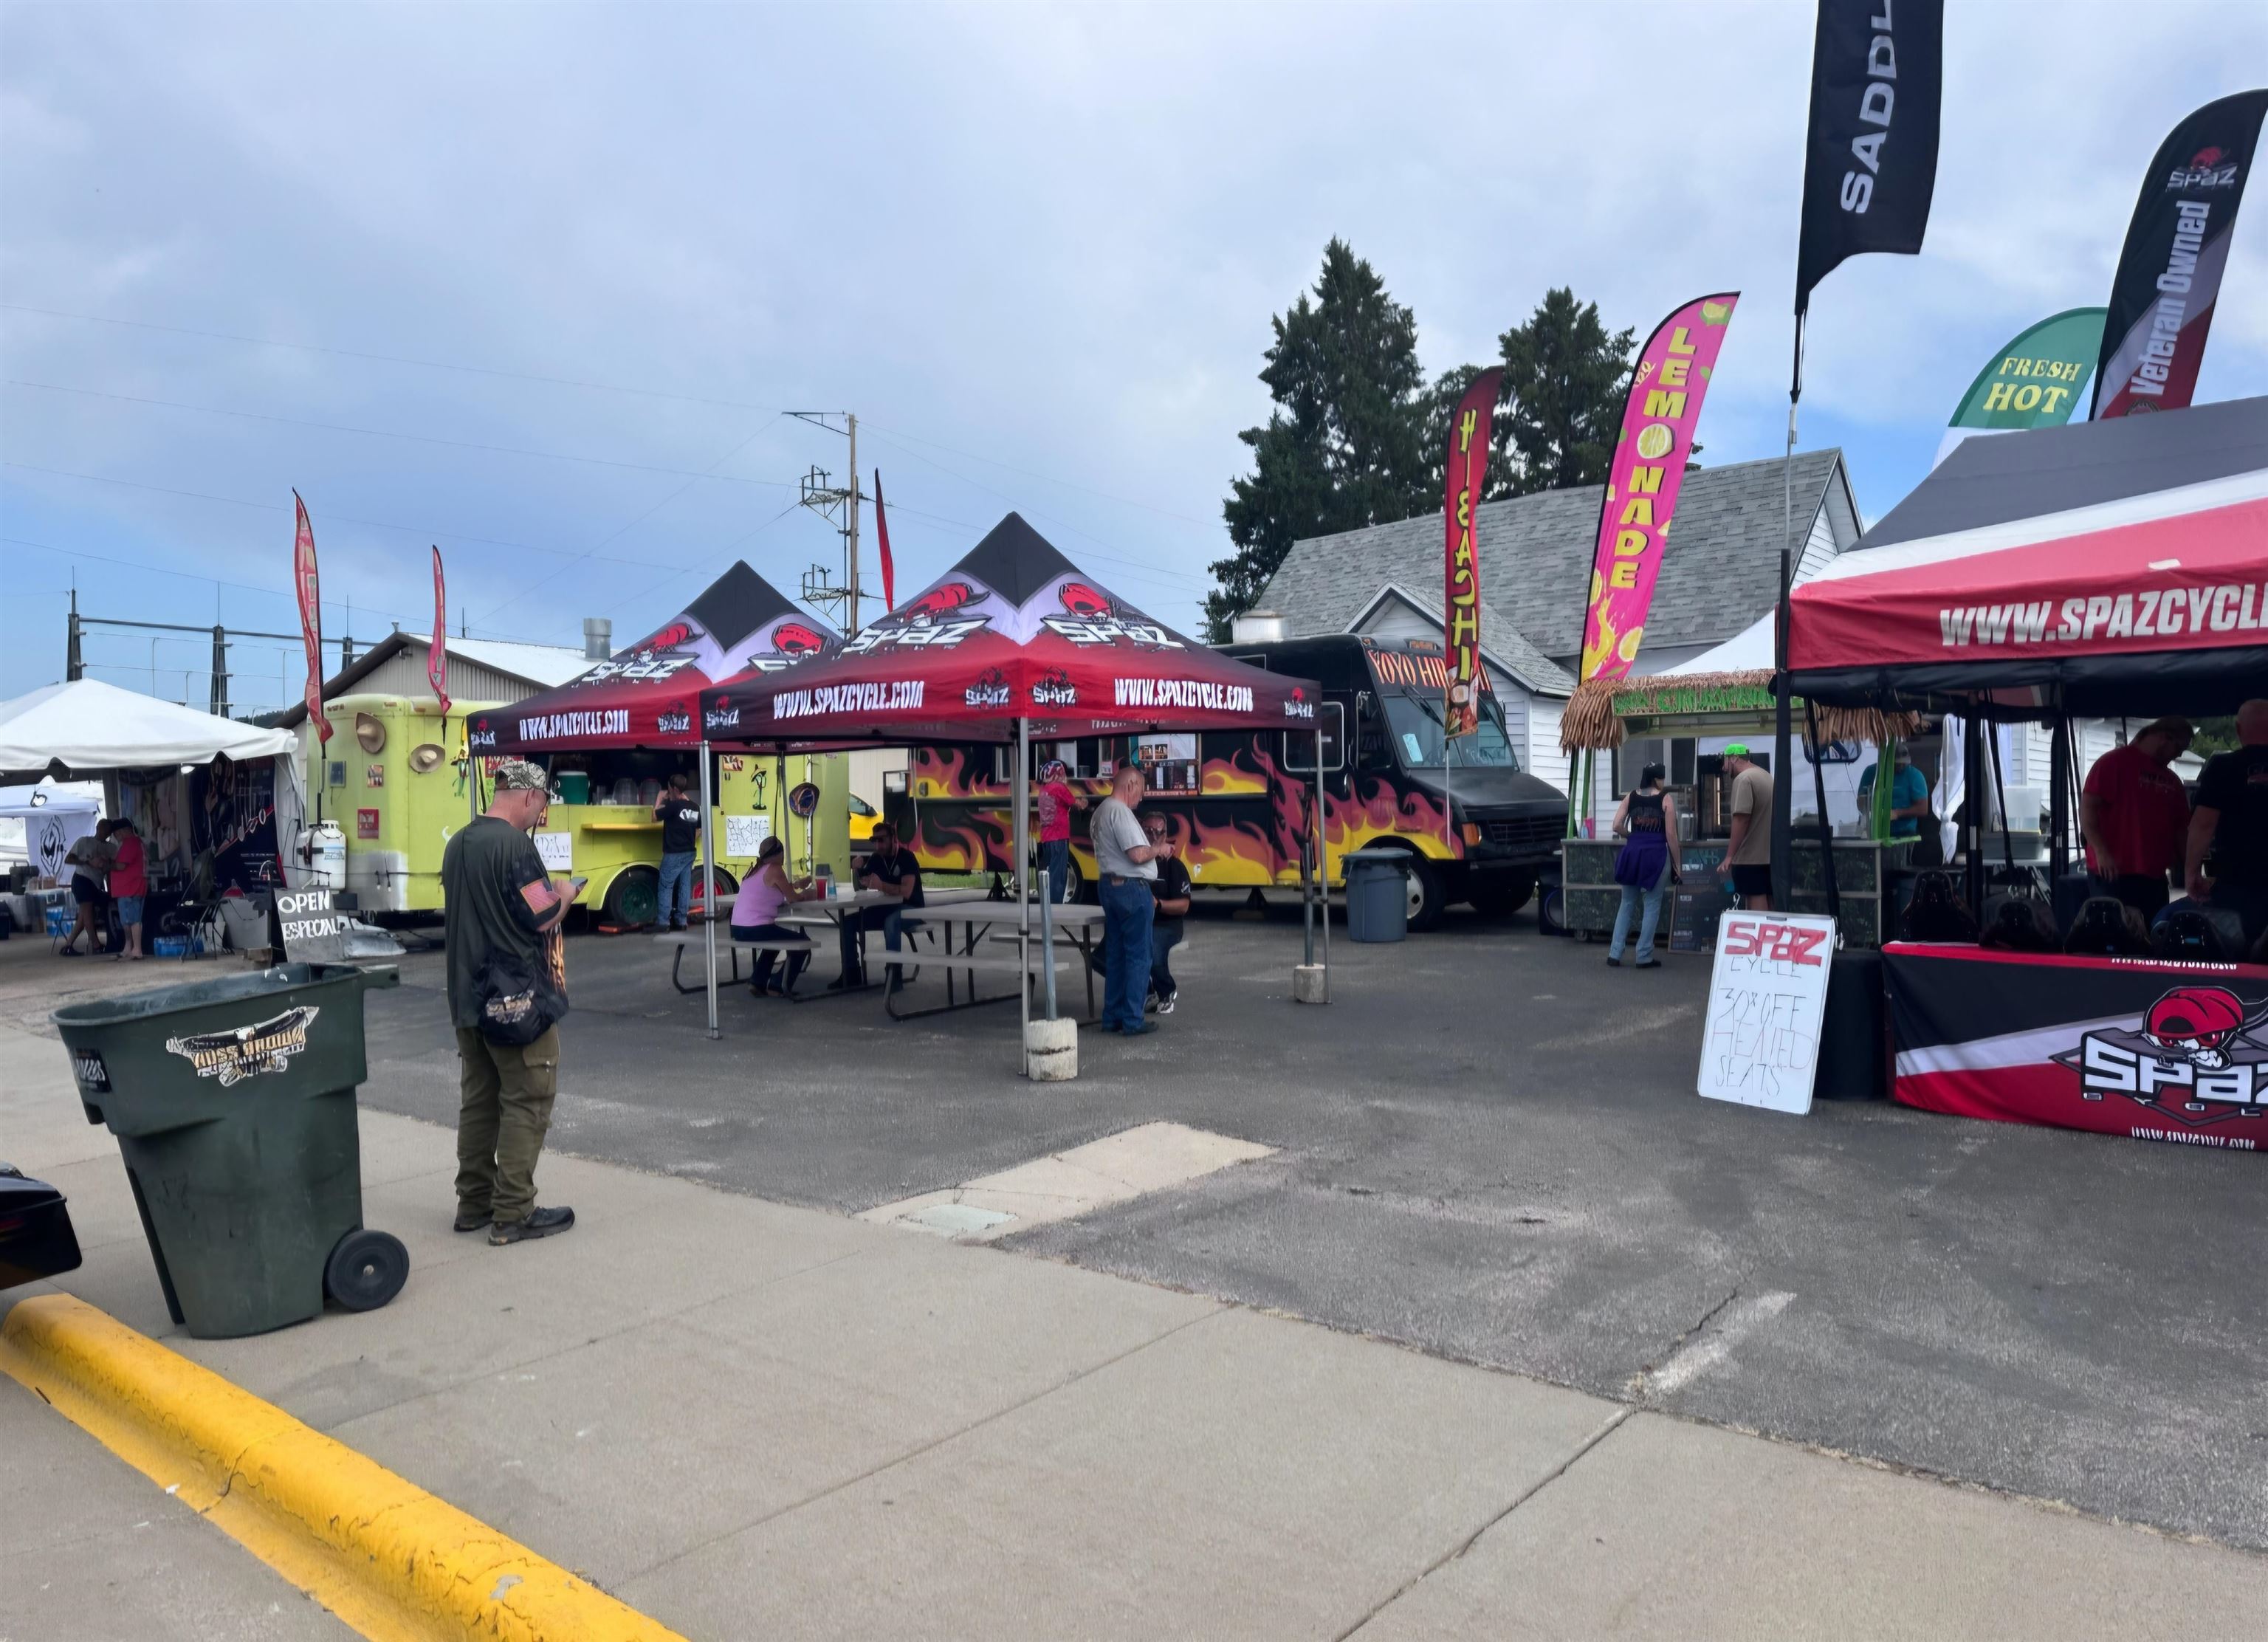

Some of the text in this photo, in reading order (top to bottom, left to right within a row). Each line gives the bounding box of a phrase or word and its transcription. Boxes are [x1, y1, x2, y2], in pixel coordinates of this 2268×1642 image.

[2129, 200, 2211, 396] Veteran Owned
[1999, 357, 2083, 382] FRESH
[1983, 382, 2069, 413] HOT
[278, 890, 330, 914] OPEN
